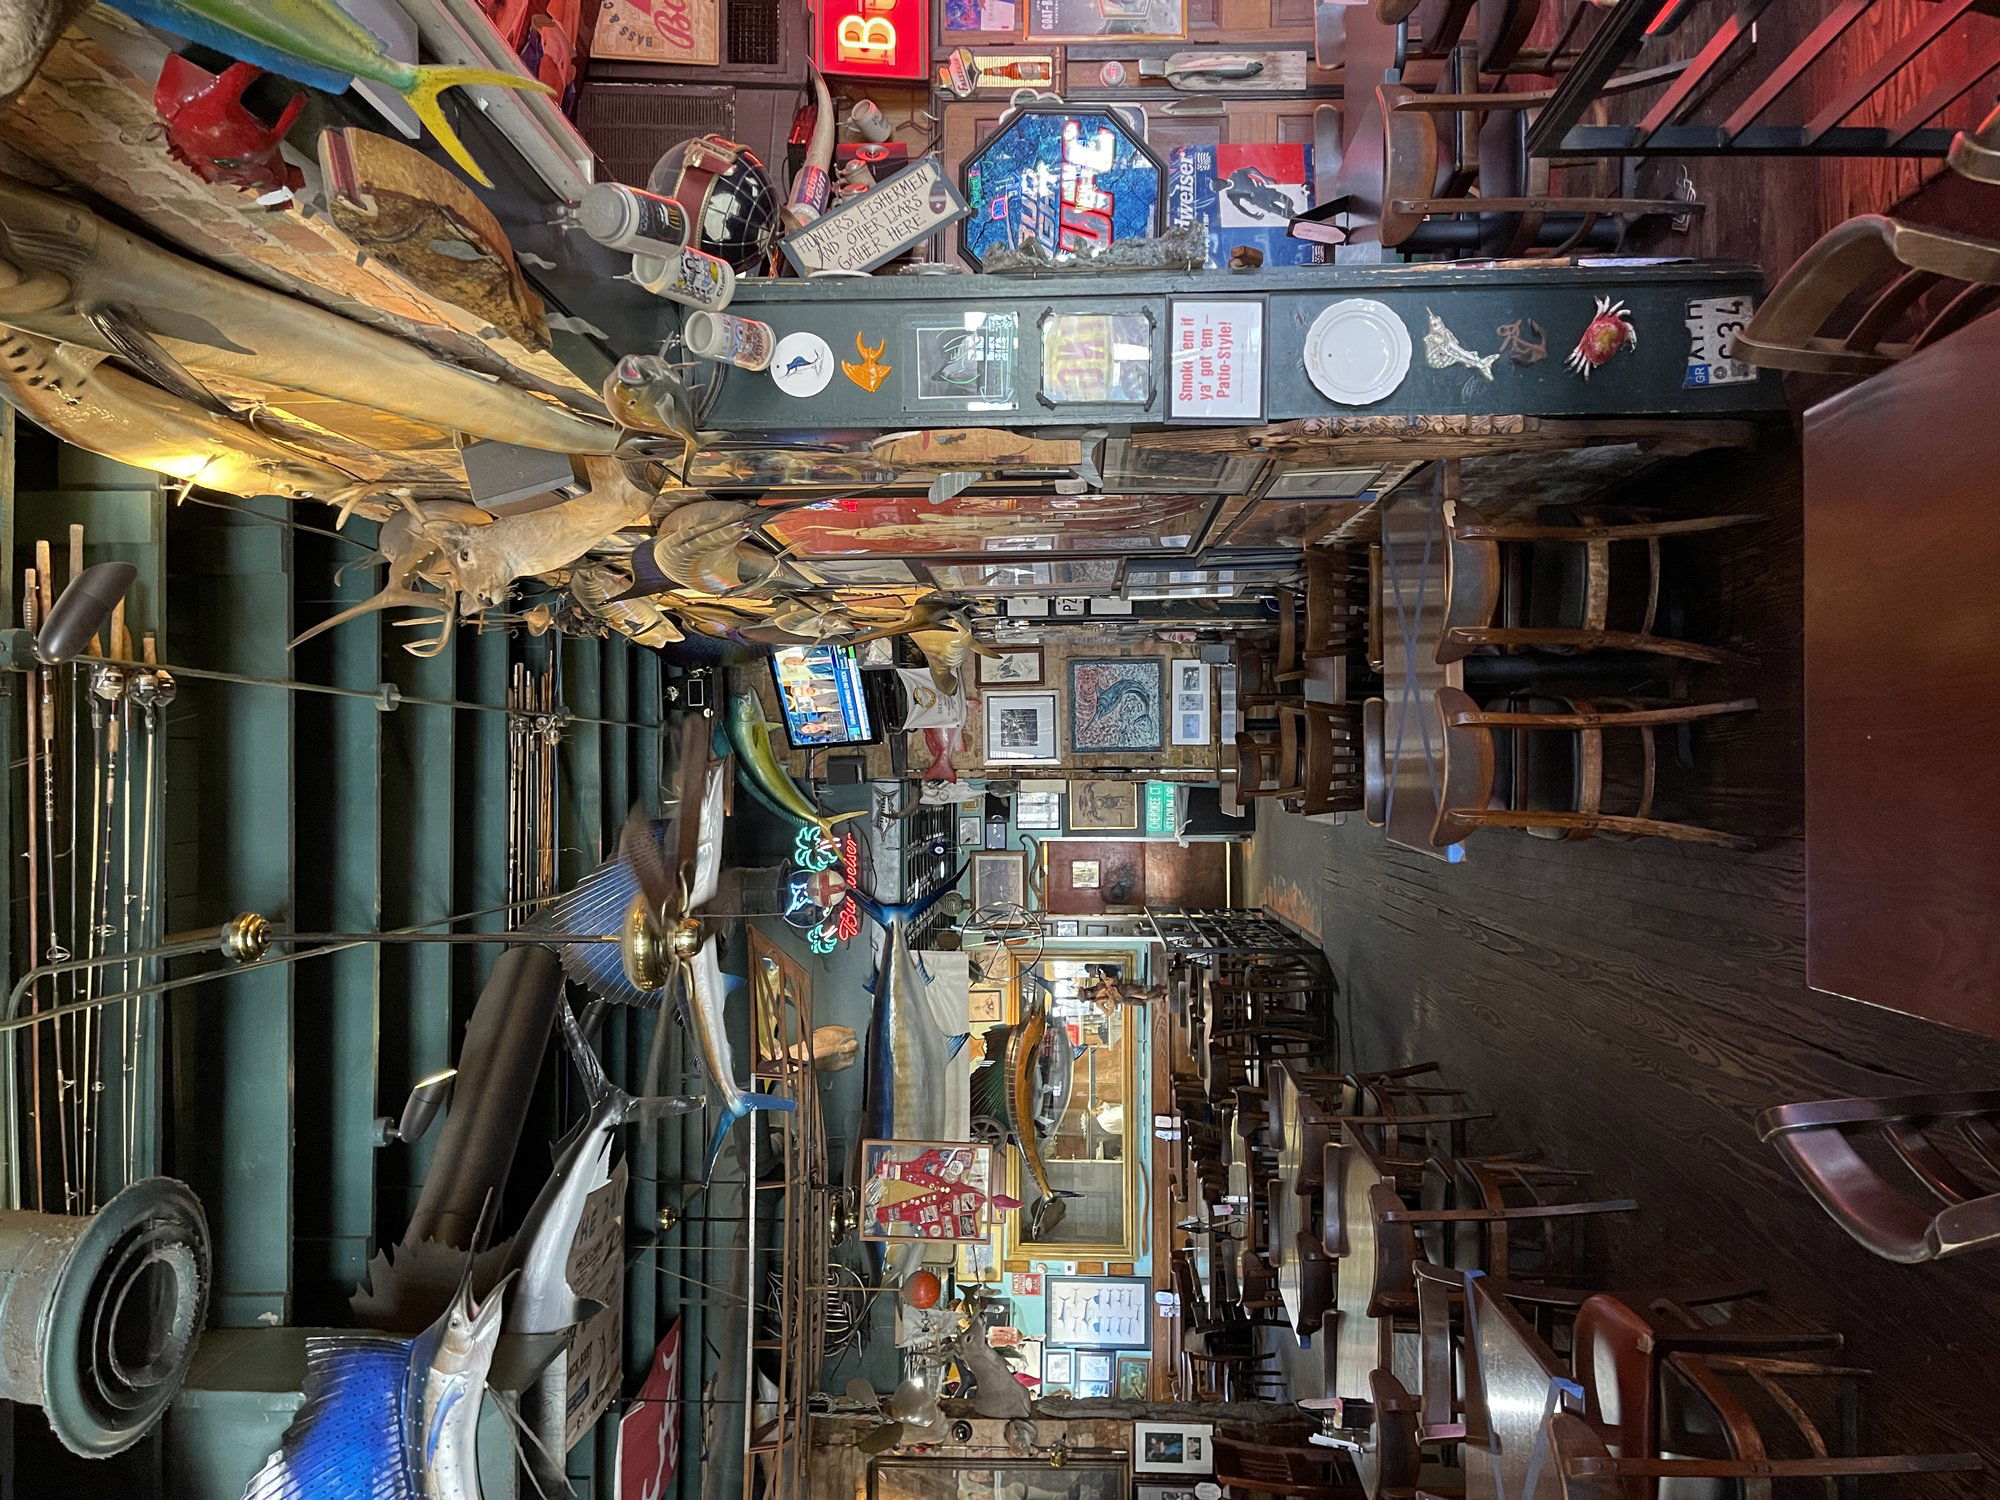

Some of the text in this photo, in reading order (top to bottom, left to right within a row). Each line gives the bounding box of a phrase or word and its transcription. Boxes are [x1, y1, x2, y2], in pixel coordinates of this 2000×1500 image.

[619, 26, 653, 48] BASS
[804, 169, 819, 198] BUD
[813, 171, 827, 210] LIGHT
[1058, 119, 1116, 252] UFC
[1174, 153, 1195, 230] dweiser
[796, 213, 860, 253] HUNTERS,
[856, 168, 929, 221] FISHERMEN
[817, 241, 840, 267] AND
[846, 218, 885, 245] OTHER
[882, 193, 923, 225] LIARS
[837, 213, 927, 271] GATHER HERE
[1180, 318, 1194, 326] if
[1200, 328, 1213, 350] 'em
[1199, 356, 1214, 376] got
[1216, 322, 1234, 398] Patio-Style!
[1694, 366, 1706, 383] GR
[1178, 361, 1194, 401] Smoke
[1199, 382, 1214, 400] ya'
[1148, 786, 1161, 829] CHEROKEE CT
[1166, 800, 1174, 829] STADIUM
